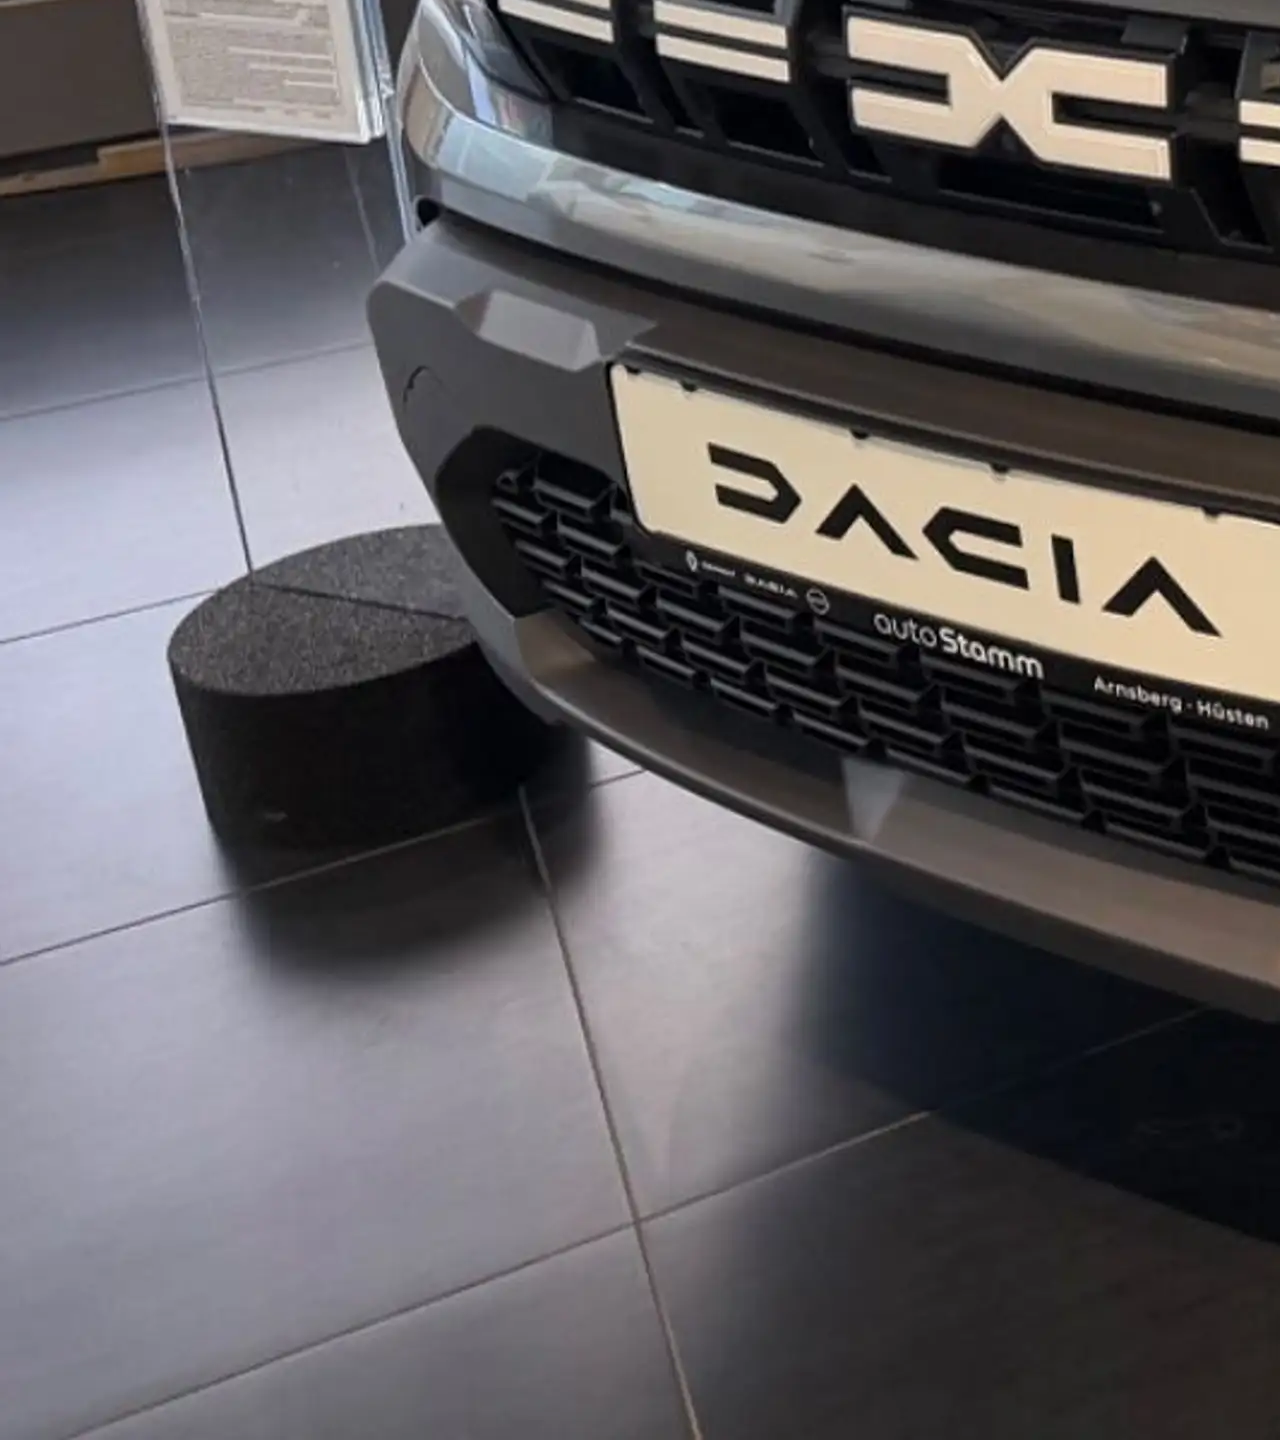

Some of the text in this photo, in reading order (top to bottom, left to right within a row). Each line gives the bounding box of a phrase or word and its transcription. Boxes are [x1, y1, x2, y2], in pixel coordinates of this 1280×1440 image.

[708, 442, 1222, 638] DACIA
[1094, 675, 1182, 713] Arnsberg
[1197, 699, 1270, 730] Hüsten
